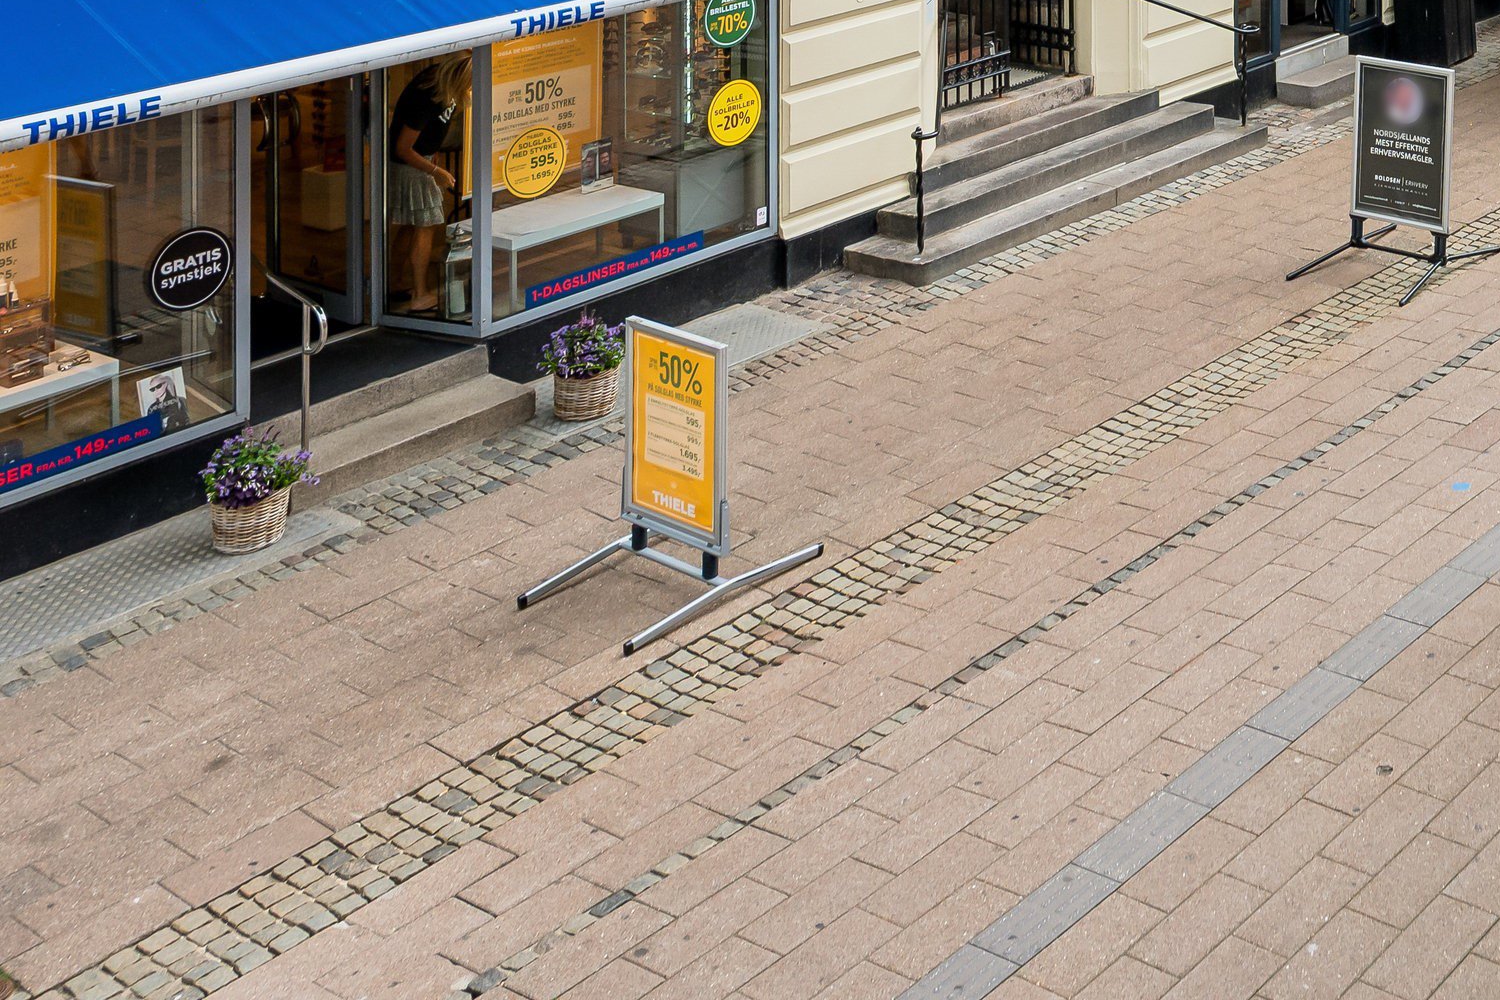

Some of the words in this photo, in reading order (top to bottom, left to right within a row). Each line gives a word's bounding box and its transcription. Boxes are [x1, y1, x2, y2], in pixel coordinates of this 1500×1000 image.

[511, 1, 605, 37] THIELE
[710, 1, 750, 16] BRILLESTEL
[718, 10, 748, 35] 70%
[524, 76, 563, 104] 50%
[726, 94, 743, 103] ALLE
[535, 103, 550, 114] MED
[552, 97, 576, 110] STYRKE
[714, 100, 755, 116] SOLBRILLER
[22, 96, 162, 145] THIELE
[716, 109, 750, 131] -20%
[518, 136, 552, 150] SOLGLAS
[1373, 128, 1431, 145] NORDSJÆLLANDS
[1375, 138, 1394, 148] MEST
[1395, 141, 1429, 154] EFFEKTIVE
[512, 149, 528, 159] MED
[530, 142, 558, 155] STYRKE
[1370, 146, 1434, 165] ERHVERVSMÆGLER.
[1374, 174, 1401, 184] BOLDSEN
[1405, 179, 1429, 189] ERHVERV
[160, 247, 222, 275] GRATIS
[160, 262, 222, 289] synstjek
[532, 261, 625, 302] 1-DAGSLINSER
[659, 350, 703, 396] 50%
[36, 461, 56, 473] FRA
[57, 455, 74, 467] KR.
[118, 434, 132, 445] PR.
[134, 427, 151, 439] MD.
[652, 489, 696, 519] THIELE
